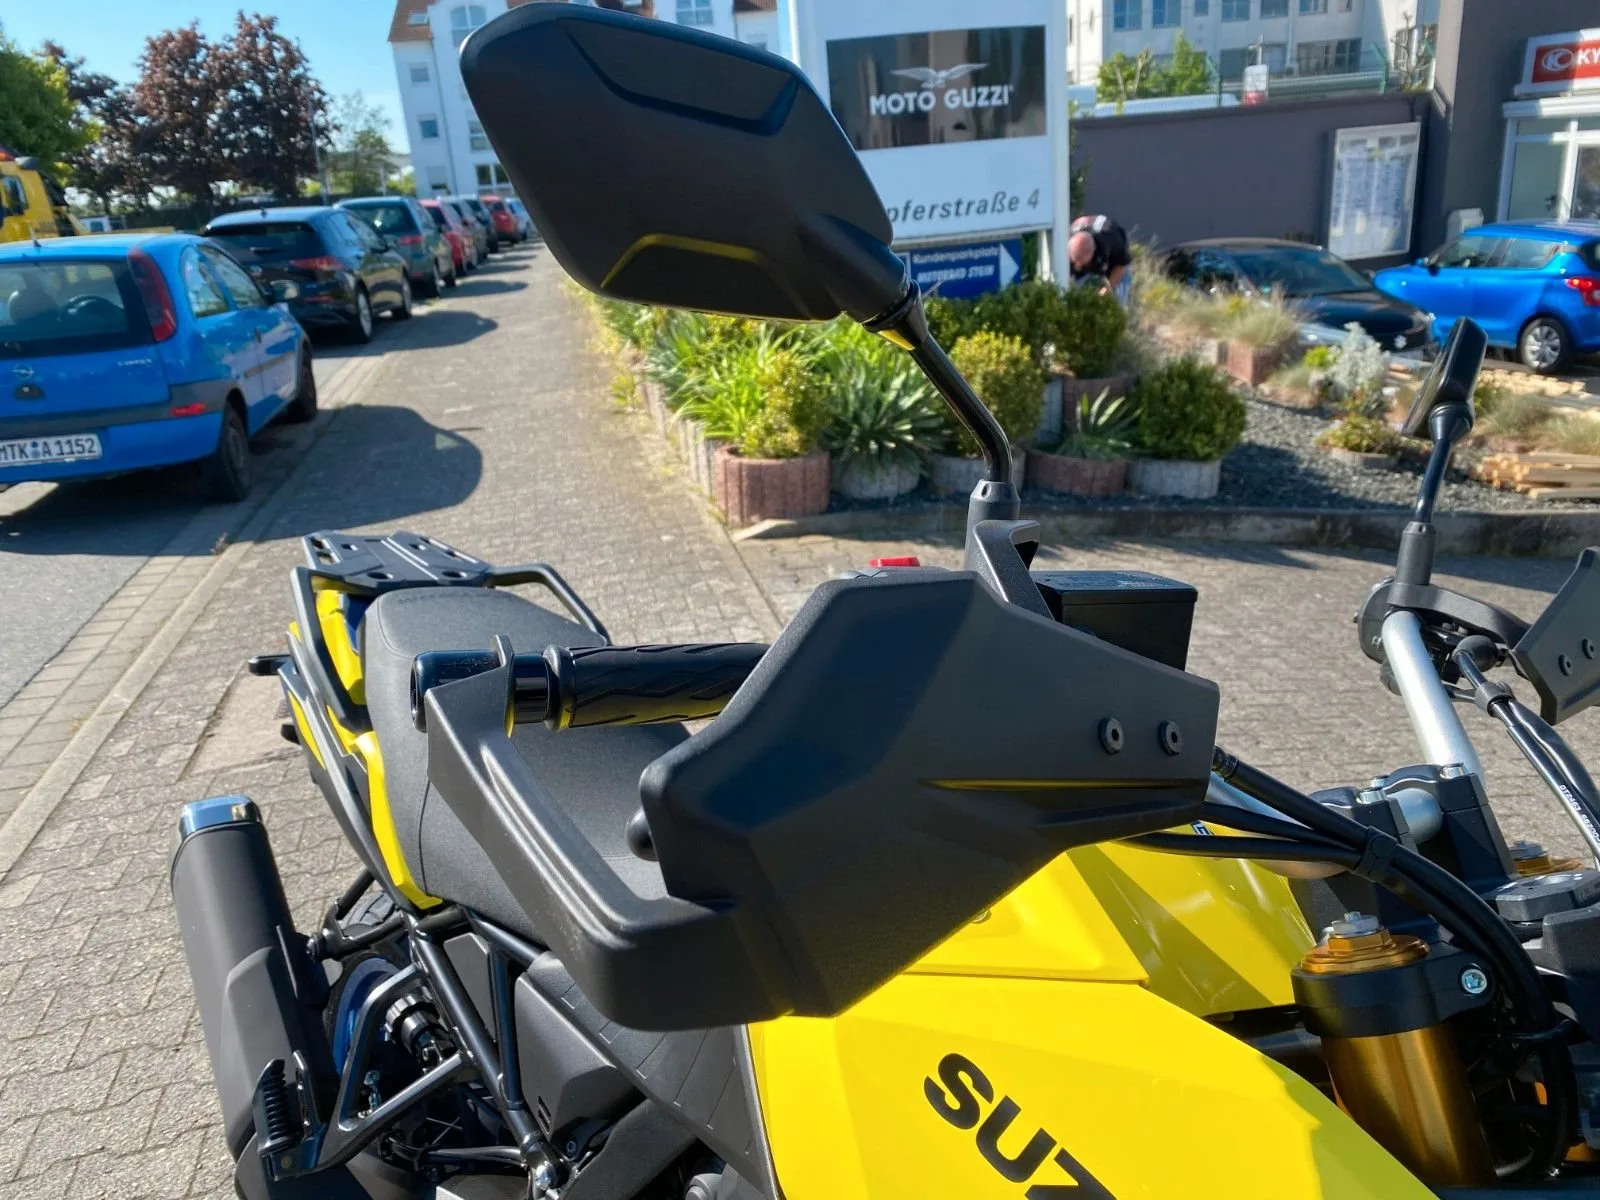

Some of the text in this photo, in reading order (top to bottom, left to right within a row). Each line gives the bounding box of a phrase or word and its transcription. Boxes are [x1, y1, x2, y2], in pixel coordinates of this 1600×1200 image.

[869, 84, 1009, 116] MOTO GUZZI
[1027, 188, 1040, 210] 4
[912, 246, 1000, 265] Kundenparkplatz
[968, 264, 995, 278] STEIN
[54, 438, 97, 456] 1152
